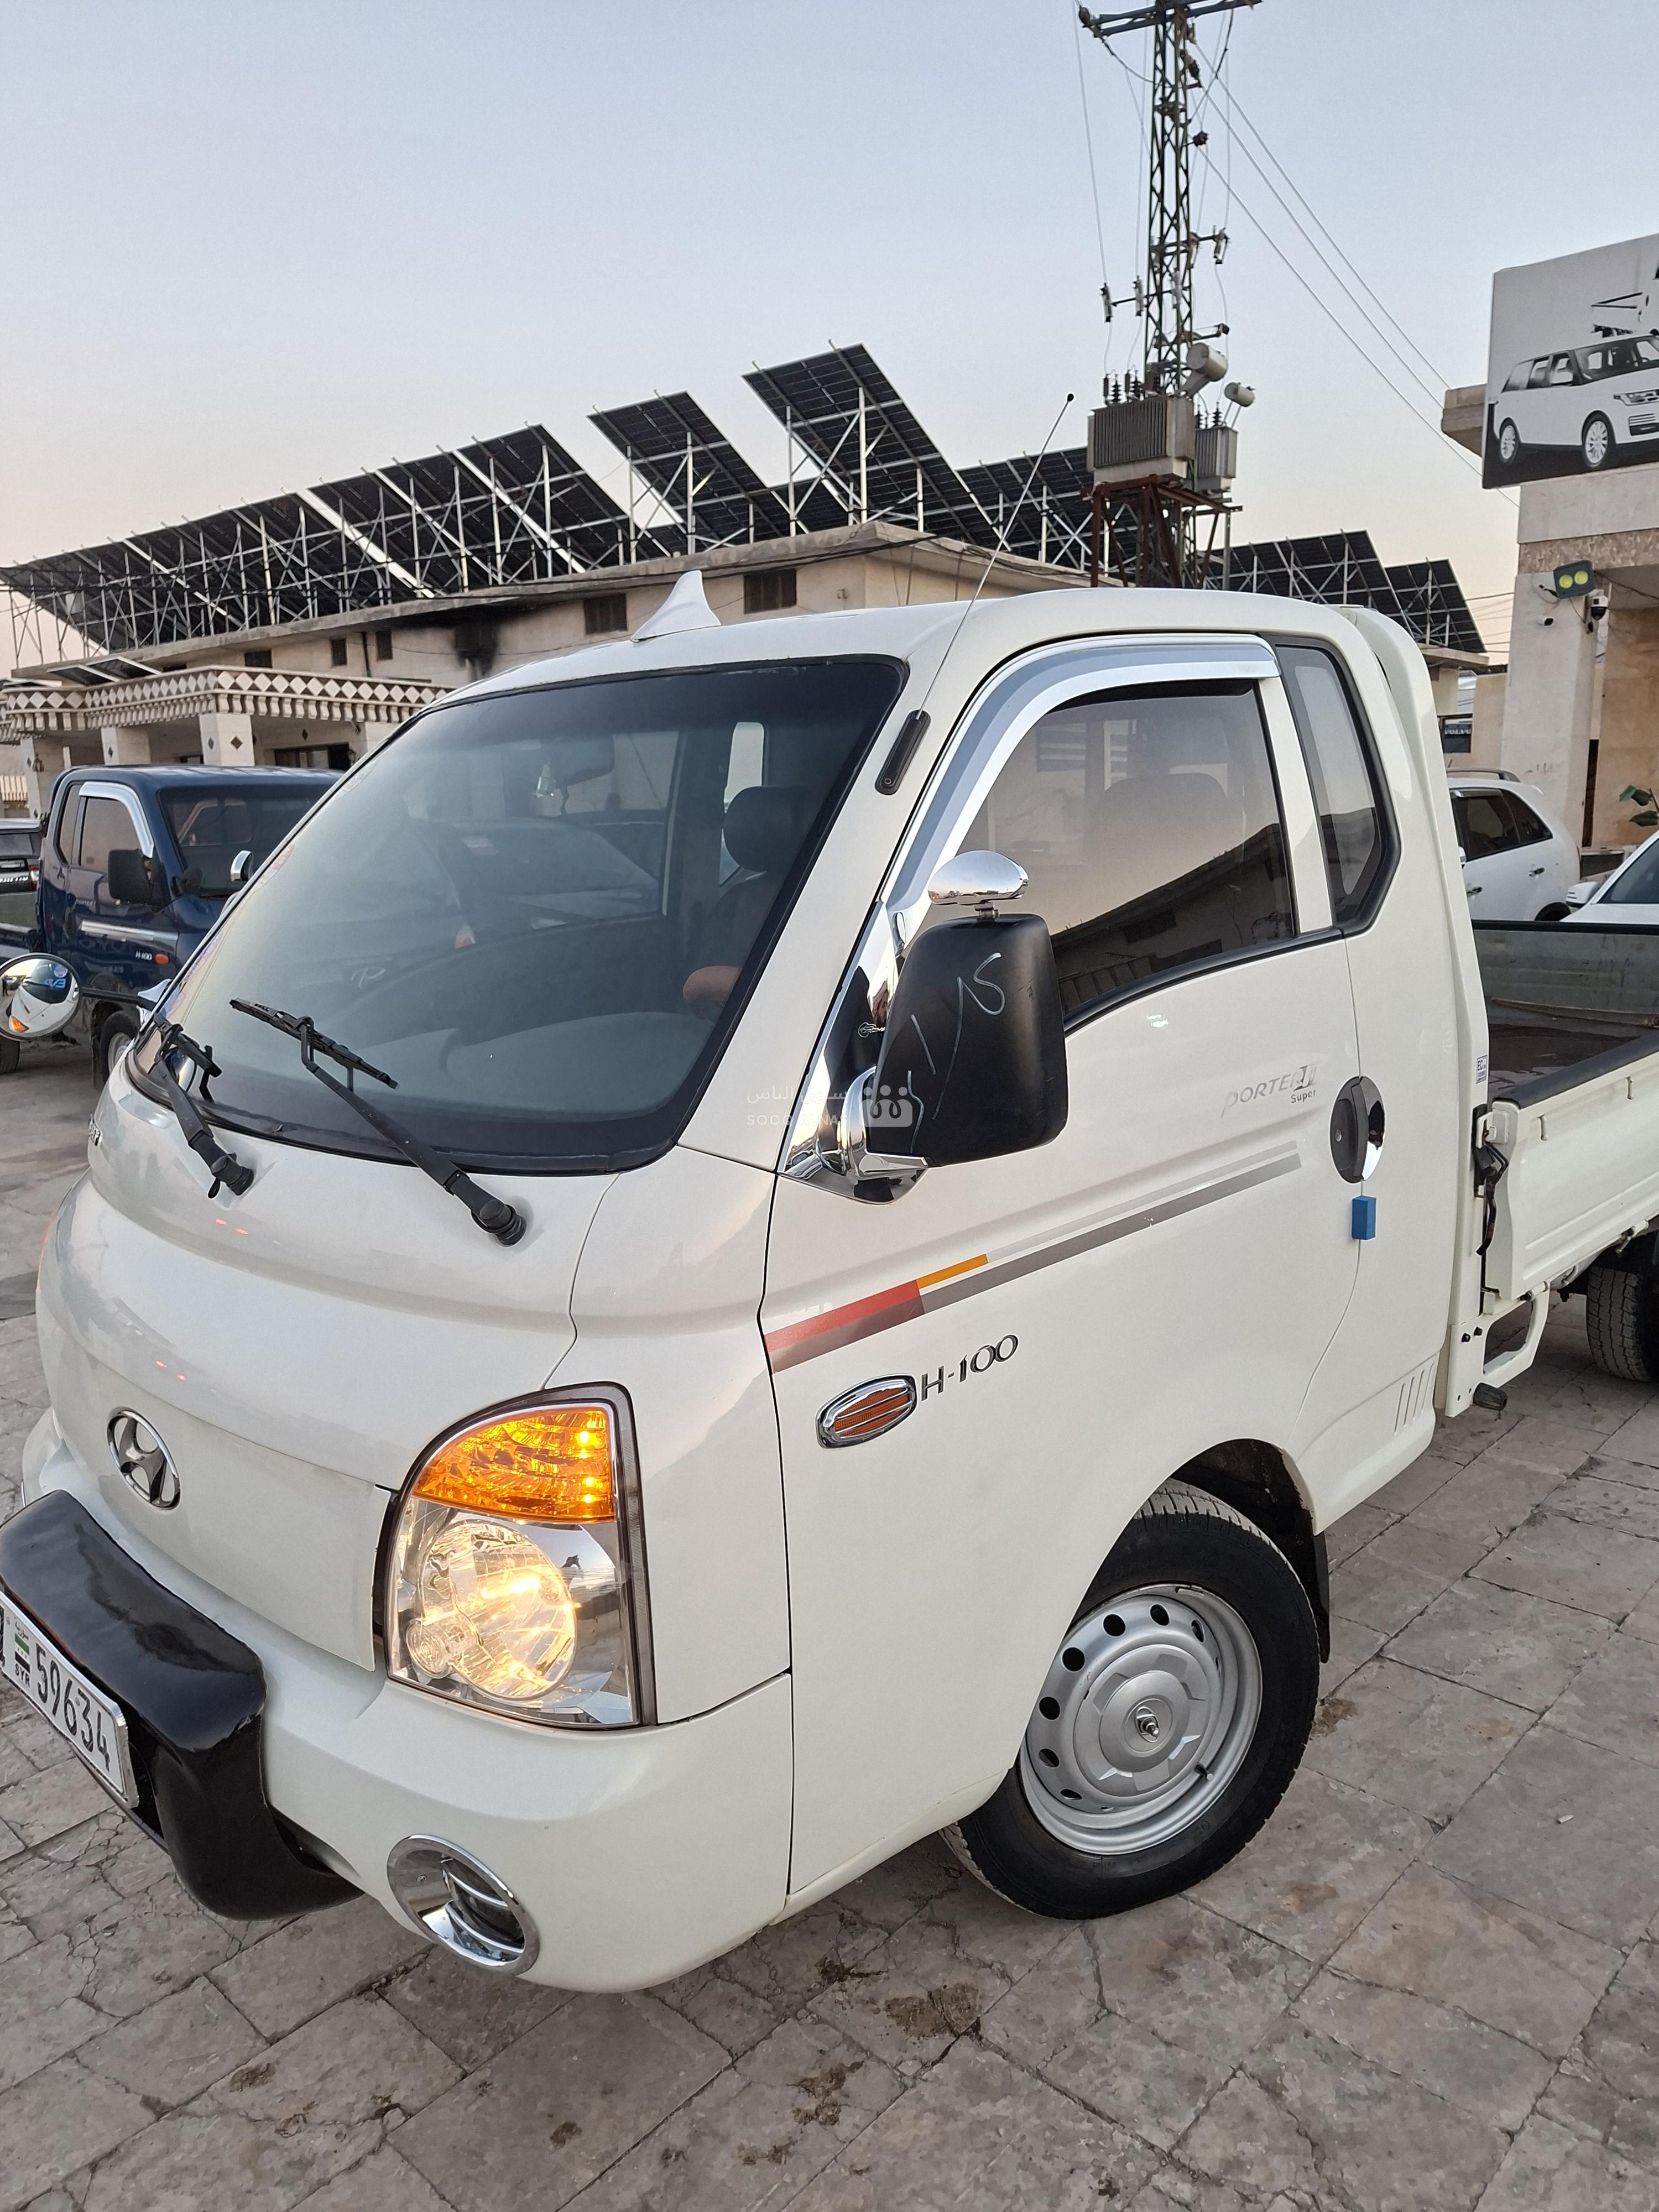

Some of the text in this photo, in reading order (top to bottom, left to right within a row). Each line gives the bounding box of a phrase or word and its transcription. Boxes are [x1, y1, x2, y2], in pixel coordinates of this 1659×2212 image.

[1291, 1089, 1317, 1104] Super
[921, 1334, 1019, 1401] H-100
[14, 1663, 31, 1688] SYR
[35, 1642, 111, 1773] 59634
